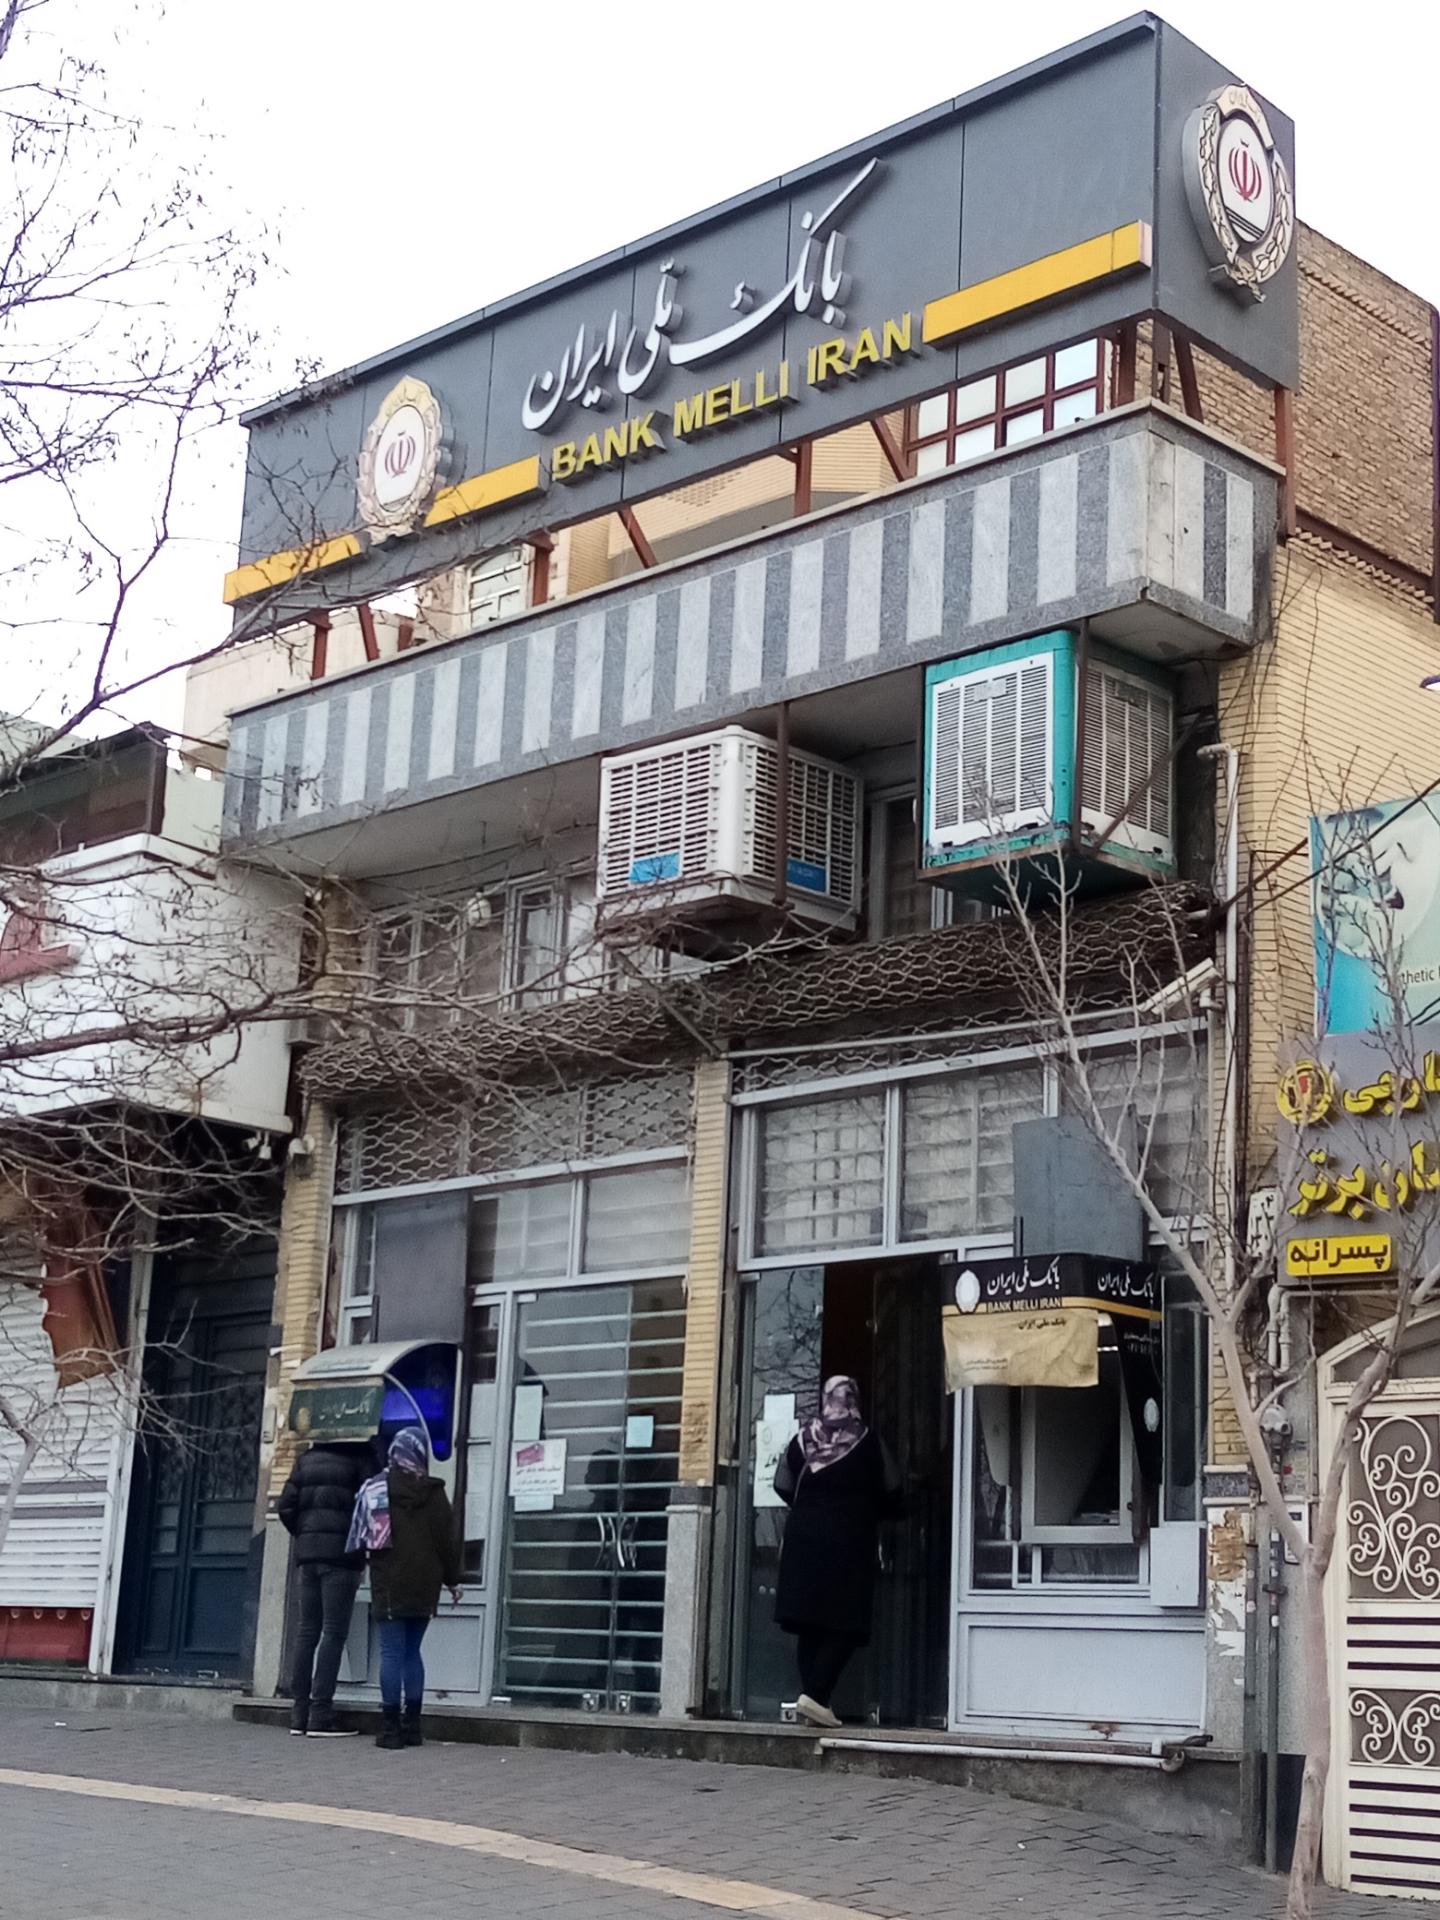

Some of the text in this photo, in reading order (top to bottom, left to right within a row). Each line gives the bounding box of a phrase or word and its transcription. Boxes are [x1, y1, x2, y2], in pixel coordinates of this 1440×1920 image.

[668, 157, 890, 366] بانک
[521, 308, 619, 431] ایران
[551, 312, 912, 482] BANK MELLI IRAN
[986, 1271, 1016, 1296] ایران
[1289, 1239, 1389, 1270] پسرانه
[987, 1296, 1061, 1314] BANK MELLI IRAN
